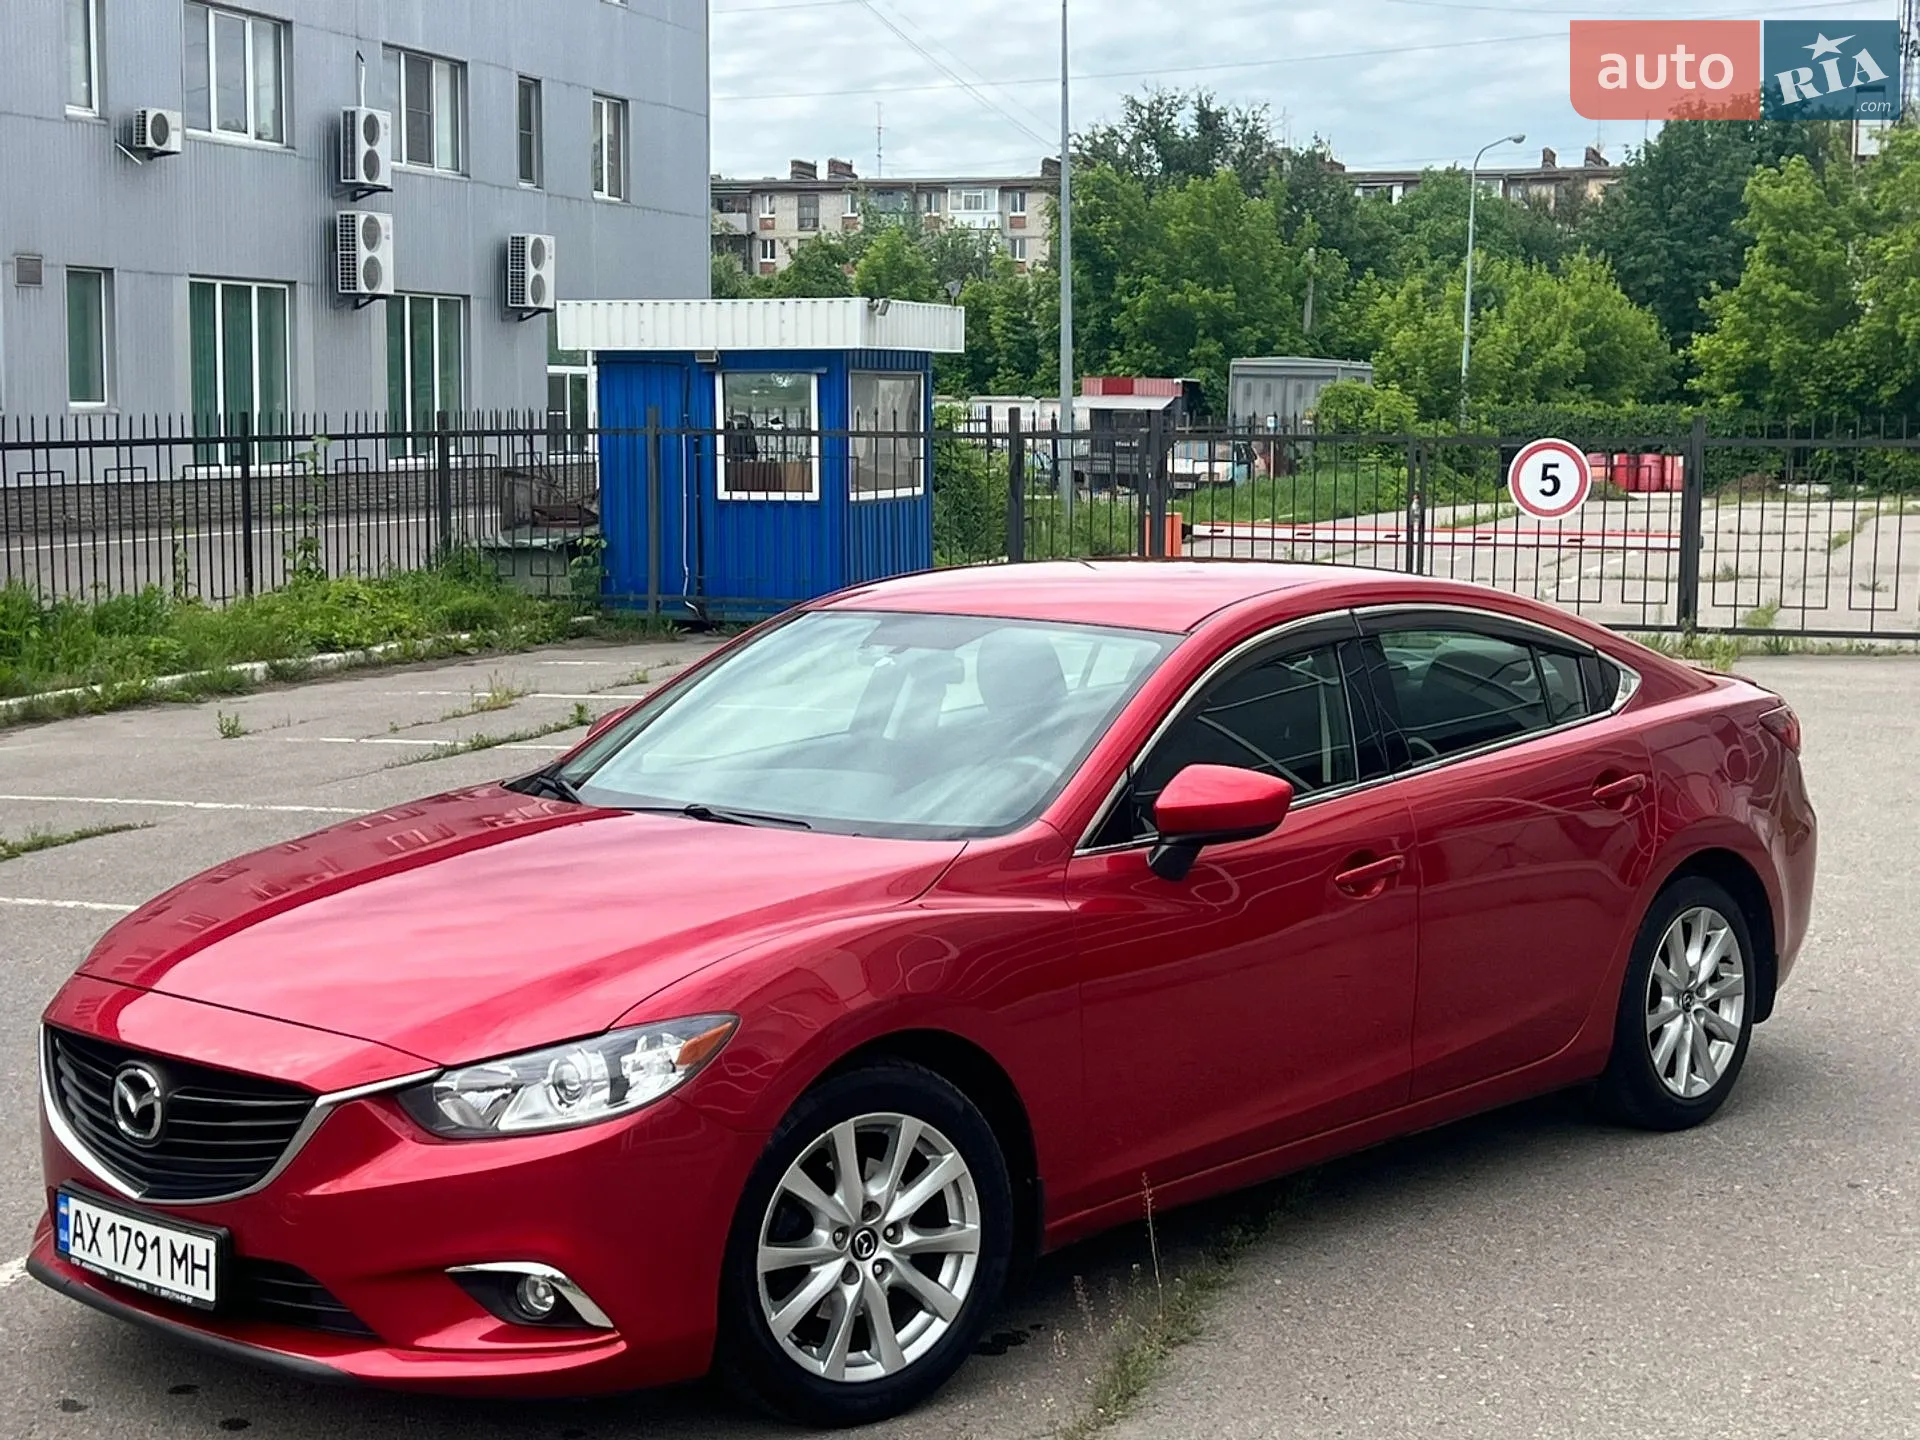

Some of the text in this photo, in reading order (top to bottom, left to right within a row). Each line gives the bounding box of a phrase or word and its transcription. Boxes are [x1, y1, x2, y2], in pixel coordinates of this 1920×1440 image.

[1539, 463, 1561, 497] 5
[72, 1210, 102, 1257] AX
[107, 1222, 162, 1277] 1791
[169, 1238, 210, 1290] MH
